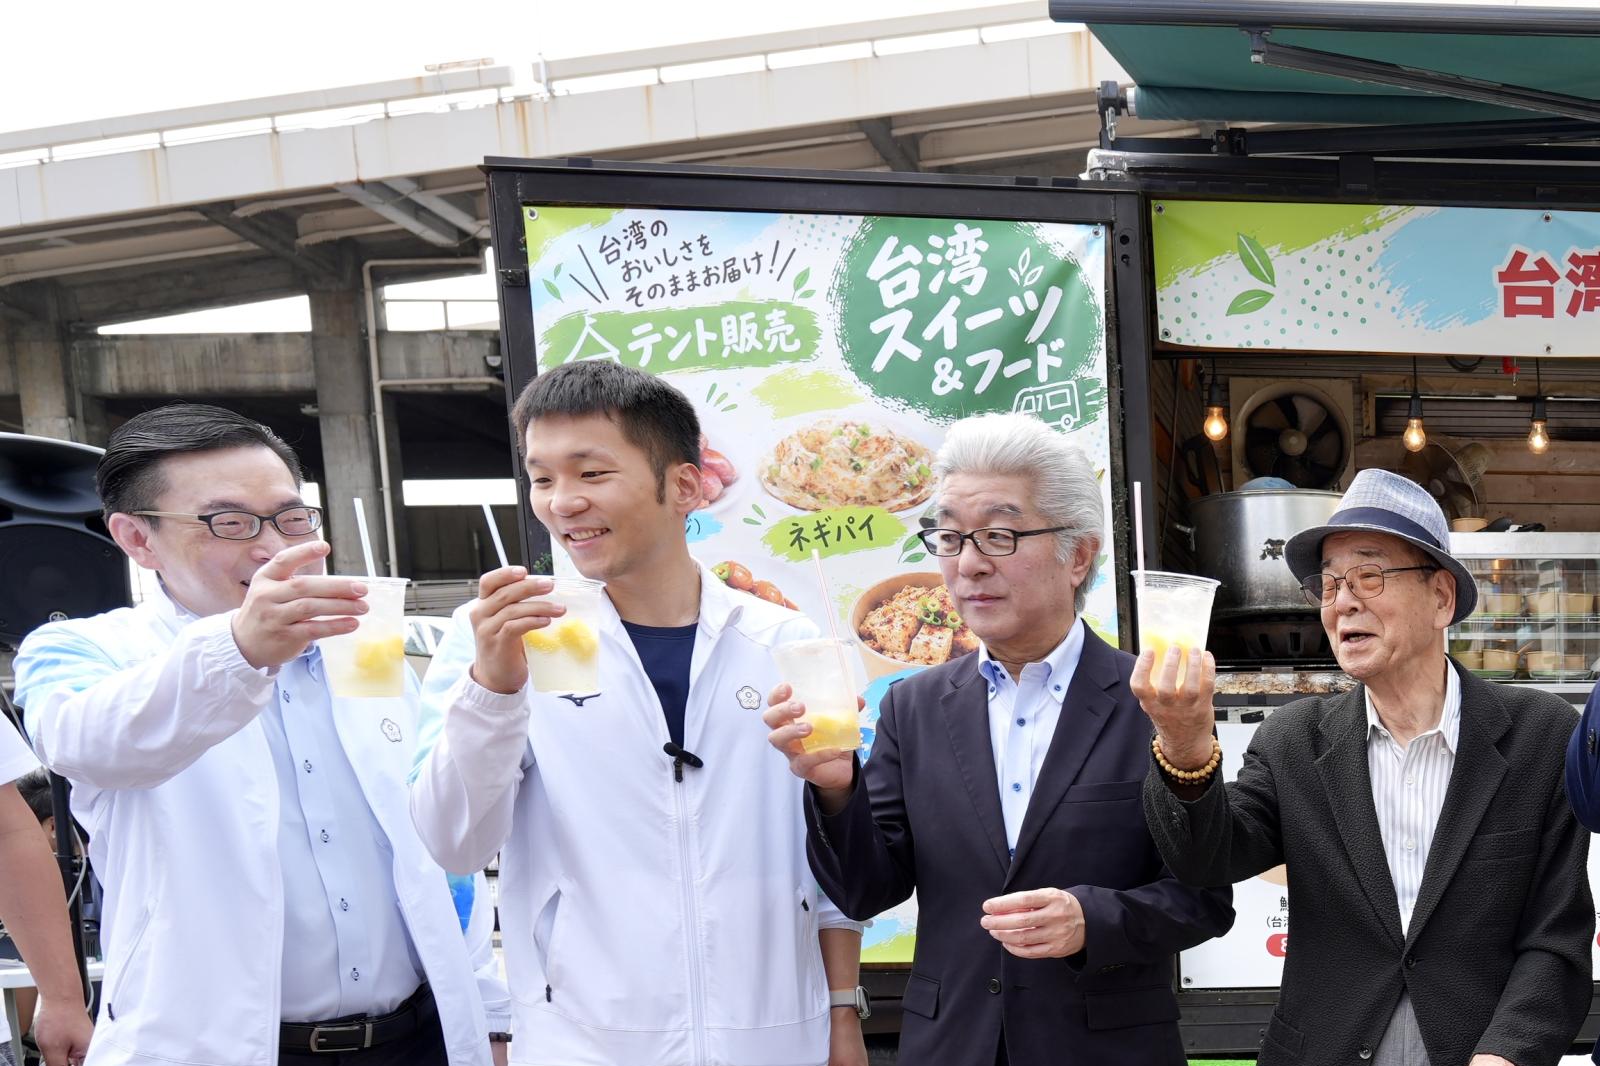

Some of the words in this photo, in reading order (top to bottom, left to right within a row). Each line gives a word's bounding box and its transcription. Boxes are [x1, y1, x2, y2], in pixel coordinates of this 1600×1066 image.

[599, 219, 668, 265] 台湾の
[622, 234, 713, 283] おいしさを
[866, 223, 989, 308] 台湾
[627, 308, 801, 368] テント販売
[869, 285, 1063, 373] スイーツ
[931, 338, 1065, 396] &フード
[789, 513, 875, 553] ネギパイ
